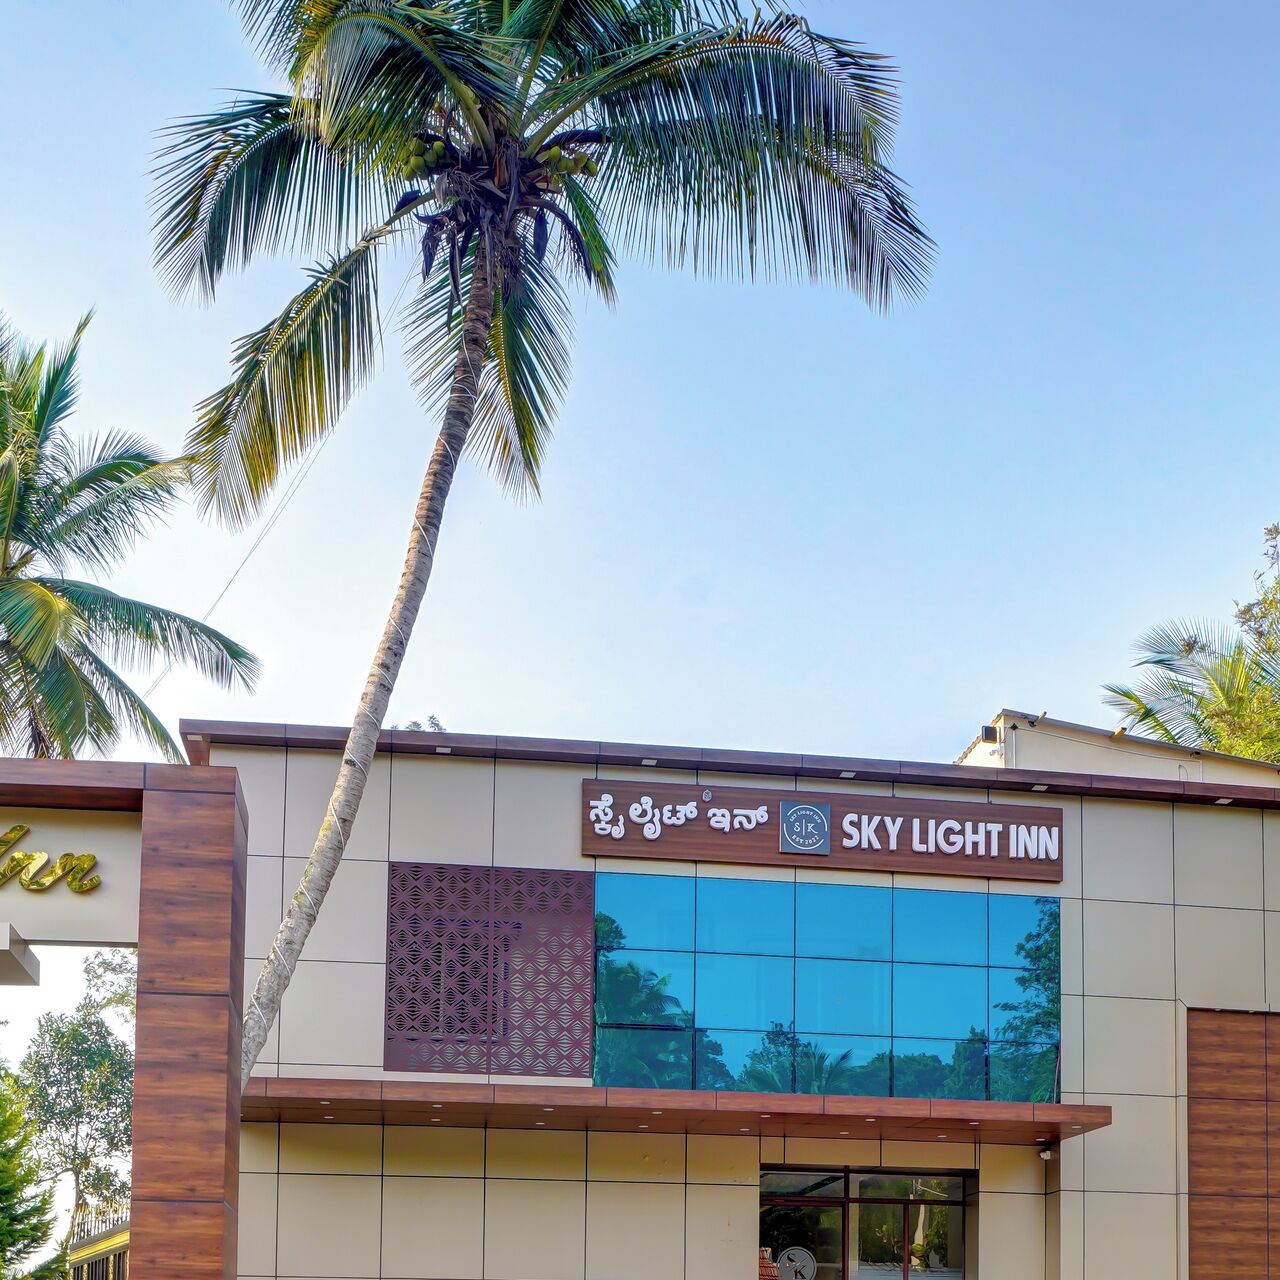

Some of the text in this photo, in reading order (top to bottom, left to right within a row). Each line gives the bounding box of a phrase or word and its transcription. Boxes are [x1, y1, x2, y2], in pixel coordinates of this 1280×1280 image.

[589, 793, 769, 841] ಸ್ಕೈ ಲೈಟ್ ಇನ್
[792, 834, 820, 845] EST 2022
[841, 813, 1059, 861] SKY LIGHT INN
